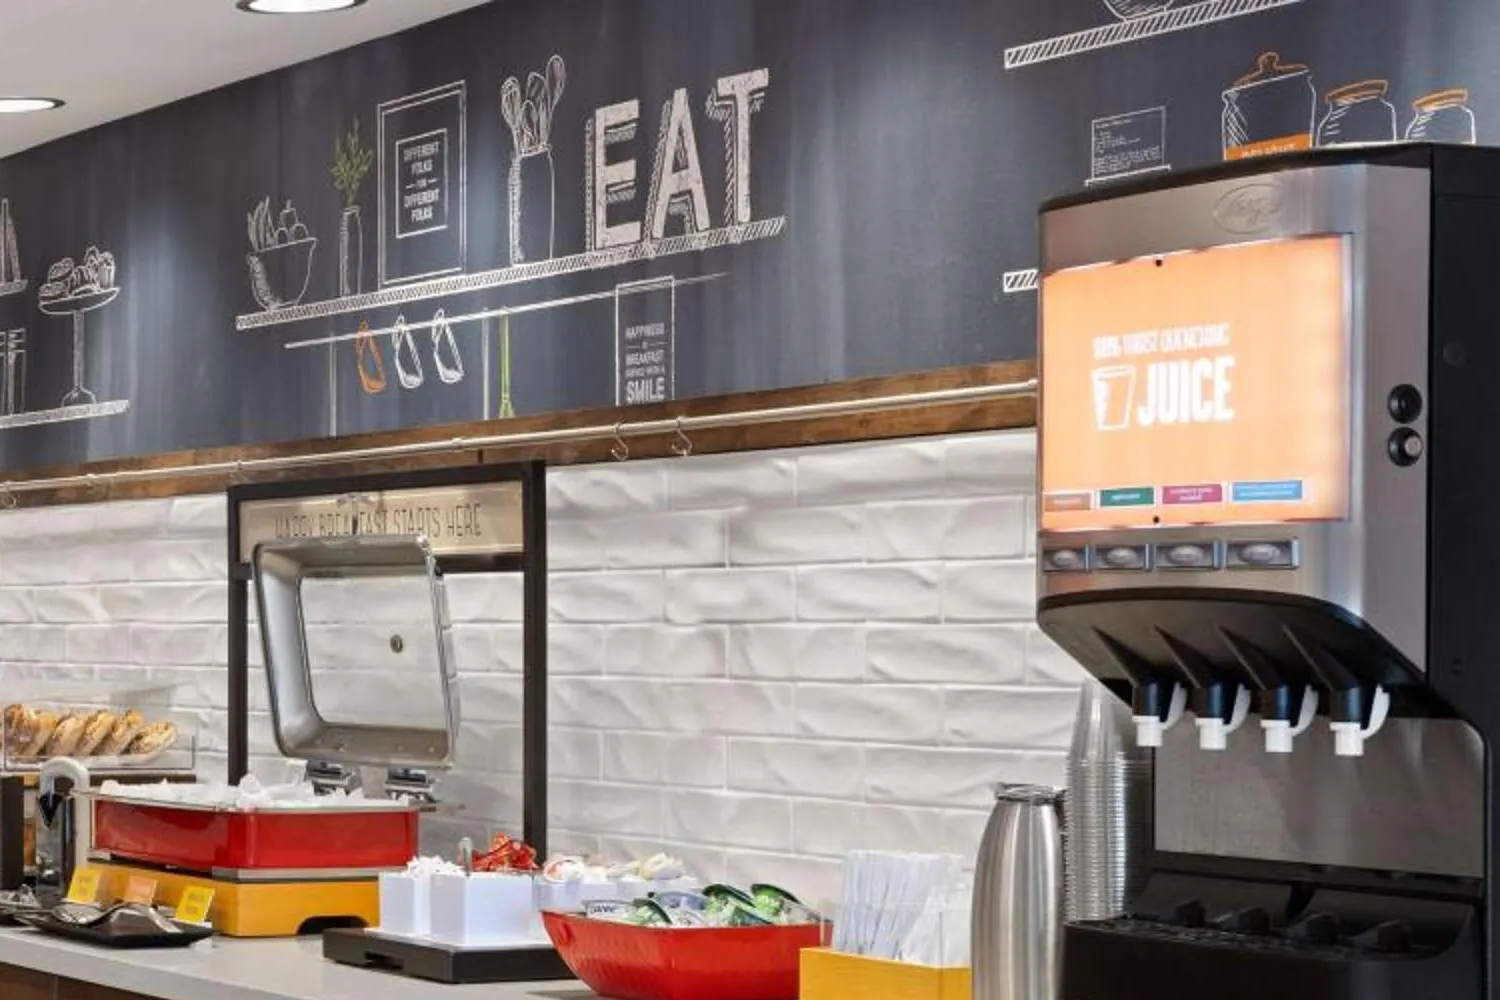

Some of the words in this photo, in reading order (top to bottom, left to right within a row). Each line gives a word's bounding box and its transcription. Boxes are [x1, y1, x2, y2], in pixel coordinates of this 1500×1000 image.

[585, 67, 769, 251] EAT
[626, 376, 665, 404] SMILE
[1137, 355, 1237, 427] JUICE
[446, 502, 483, 537] HERE
